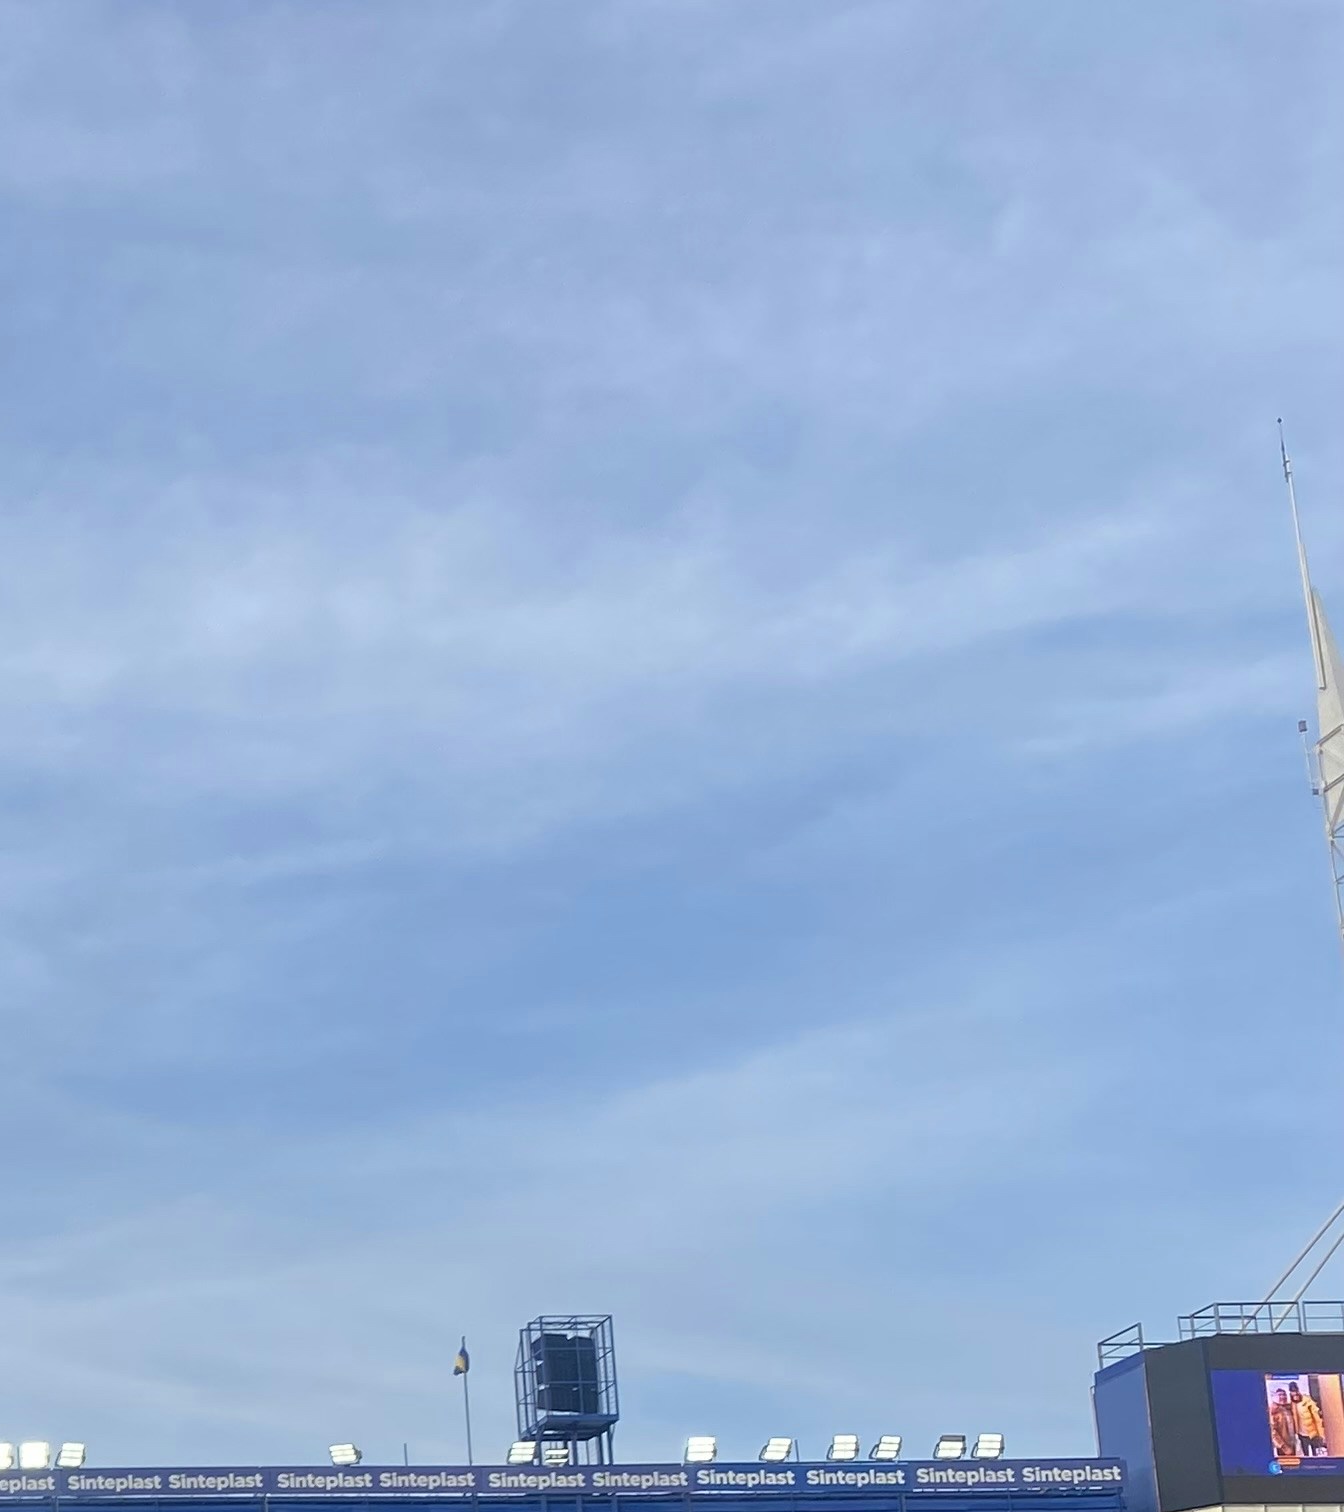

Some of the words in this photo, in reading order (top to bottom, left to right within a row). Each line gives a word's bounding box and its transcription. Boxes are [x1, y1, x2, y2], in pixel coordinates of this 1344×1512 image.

[67, 1475, 161, 1492] Sinteplast
[168, 1473, 263, 1491] Sinteplast
[277, 1473, 373, 1490] Sinteplast
[379, 1472, 475, 1490] Sinteplast
[488, 1471, 586, 1490] Sinteplast
[592, 1471, 688, 1489] Sinteplast
[696, 1470, 795, 1488] Sinteplast
[806, 1469, 906, 1487] Sinteplast
[916, 1467, 1015, 1485] Sinteplast
[1022, 1465, 1122, 1484] Sinteplast
